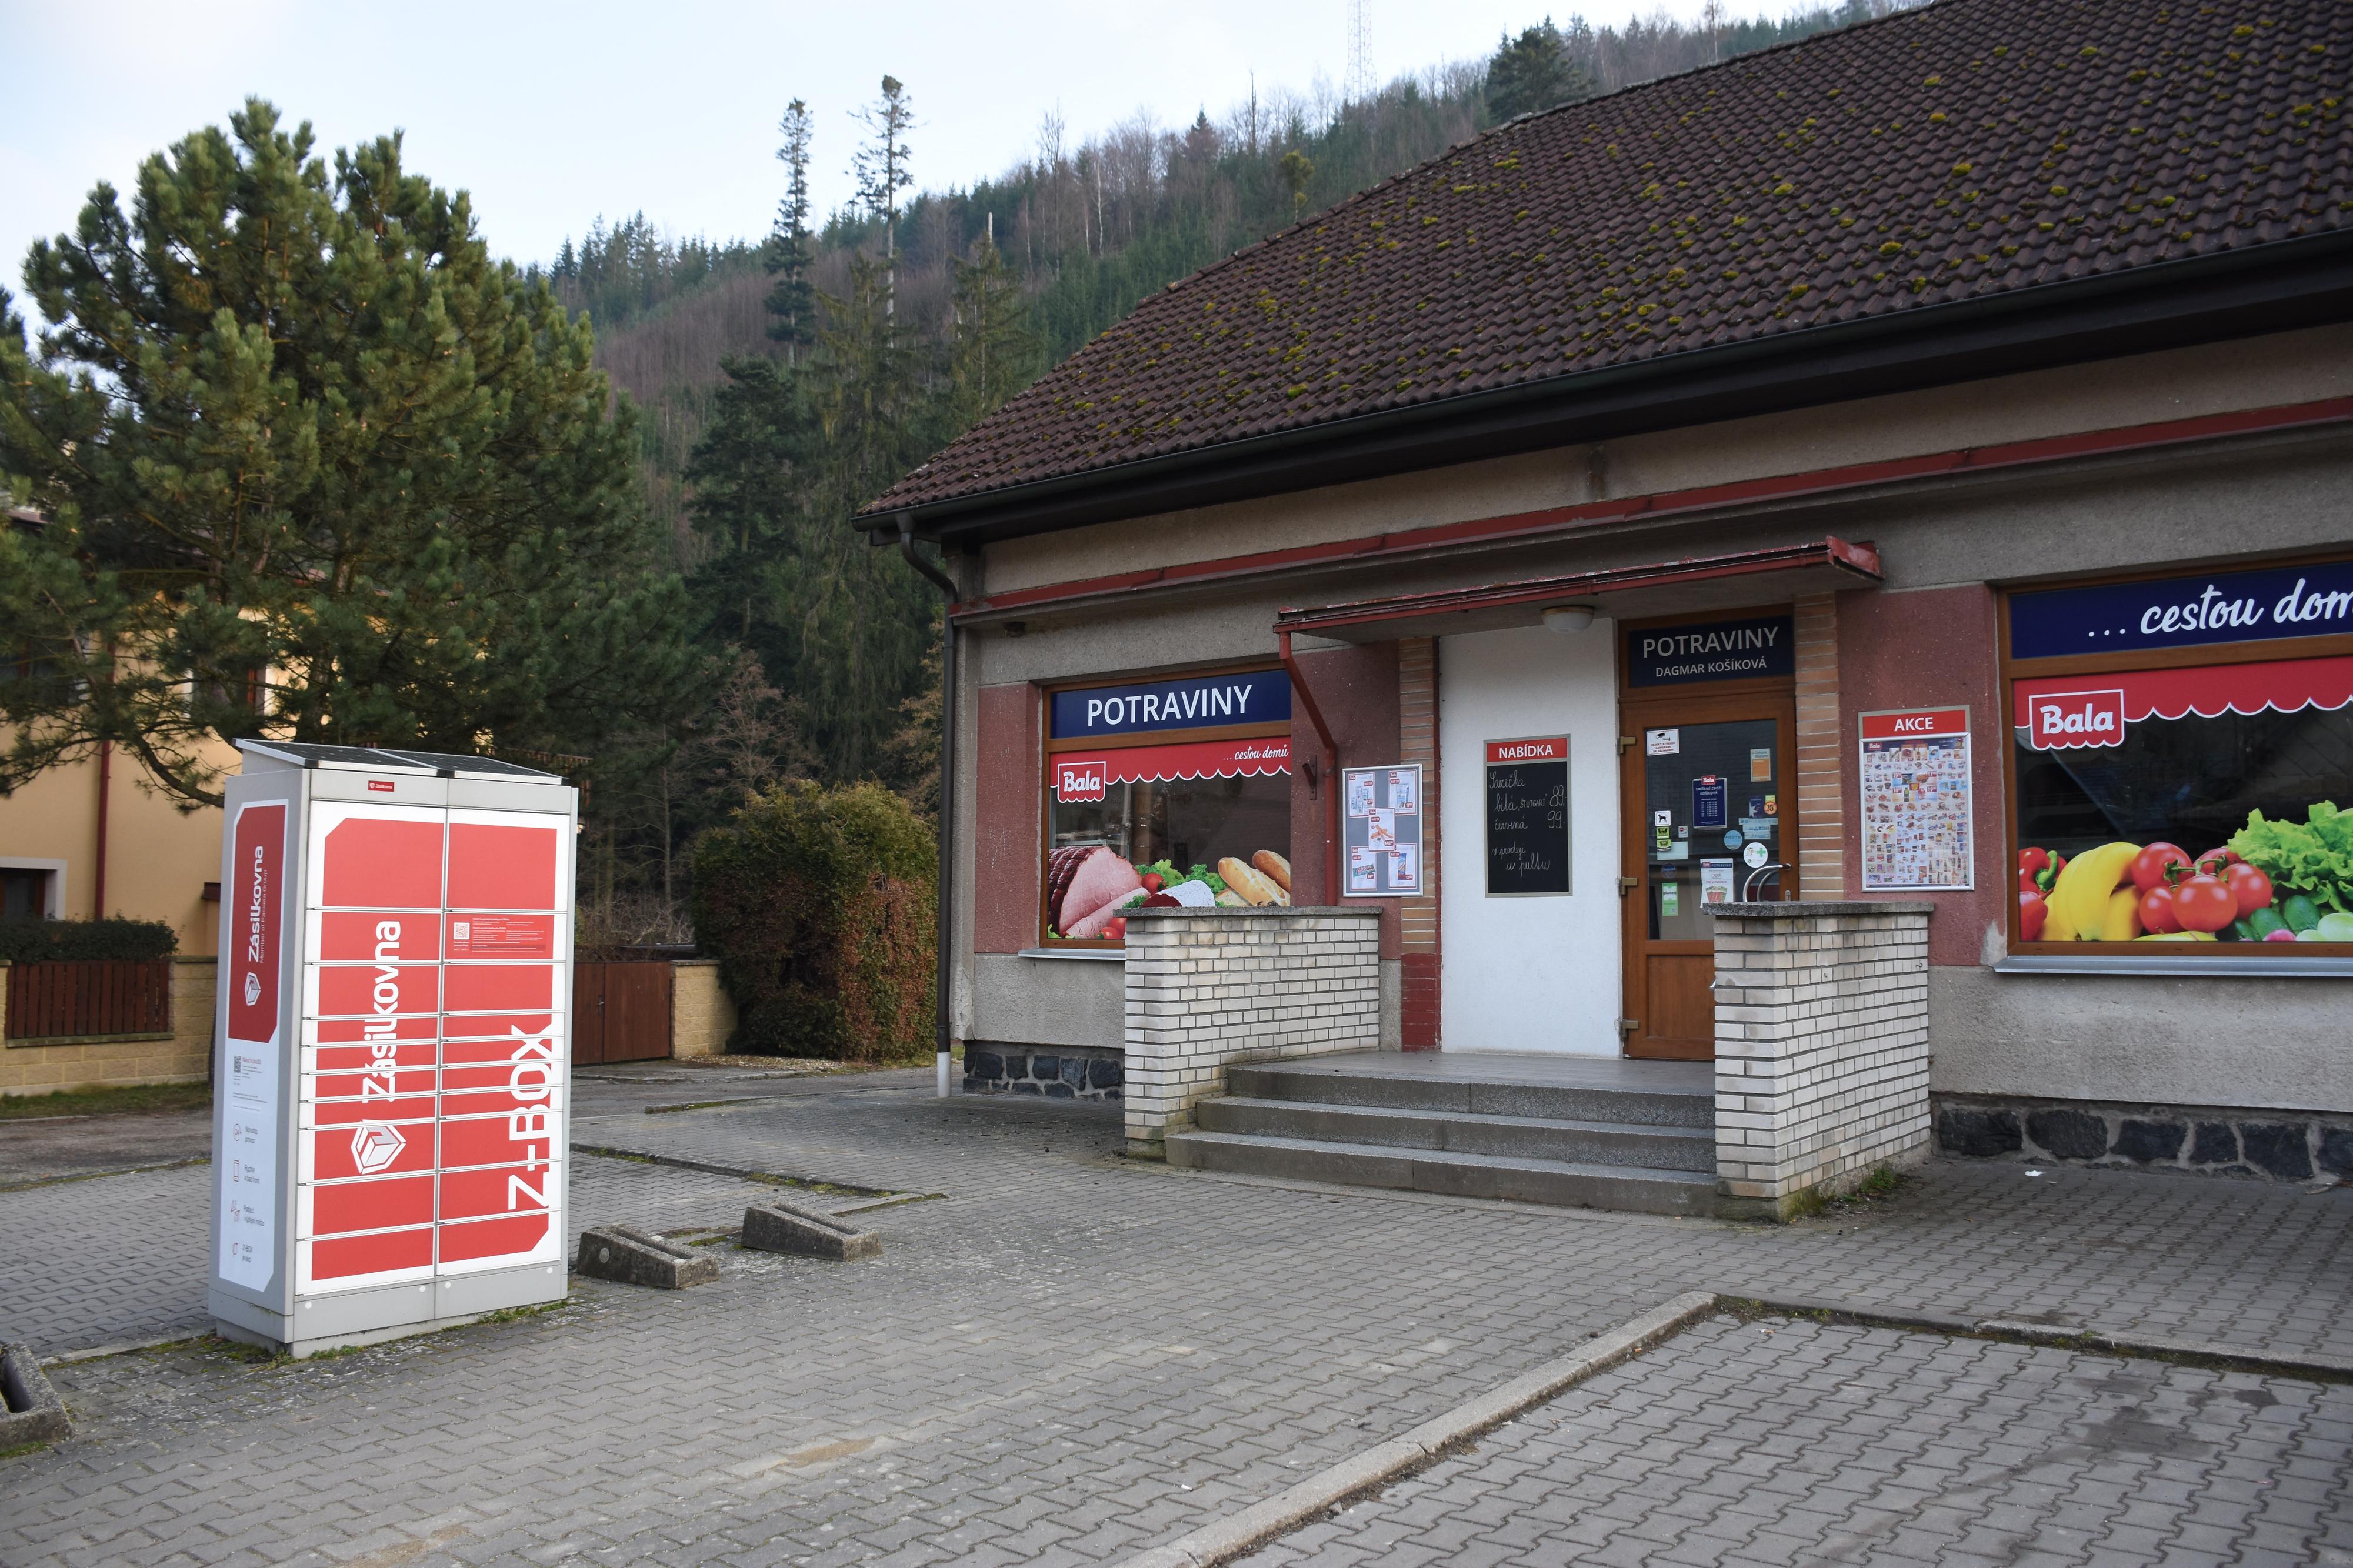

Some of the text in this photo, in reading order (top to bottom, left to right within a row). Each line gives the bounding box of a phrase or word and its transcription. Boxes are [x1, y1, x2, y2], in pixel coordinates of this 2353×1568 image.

[2140, 584, 2264, 635] cestou
[1643, 626, 1779, 658] POTRAVINY
[1655, 656, 1767, 677] DAGMAR KOŠÍKOVÁ
[1087, 684, 1252, 727] POTRAVINY
[2039, 703, 2115, 735] Bala
[1894, 716, 1934, 732] AKCE
[1234, 746, 1261, 760] cestou
[1262, 743, 1289, 759] domů
[1499, 743, 1554, 759] NABÍDKA
[1062, 770, 1101, 792] Bala
[248, 846, 264, 962] Zásilkovna
[362, 920, 401, 1103] Zásilkovna
[508, 1024, 552, 1210] Z-BOX
